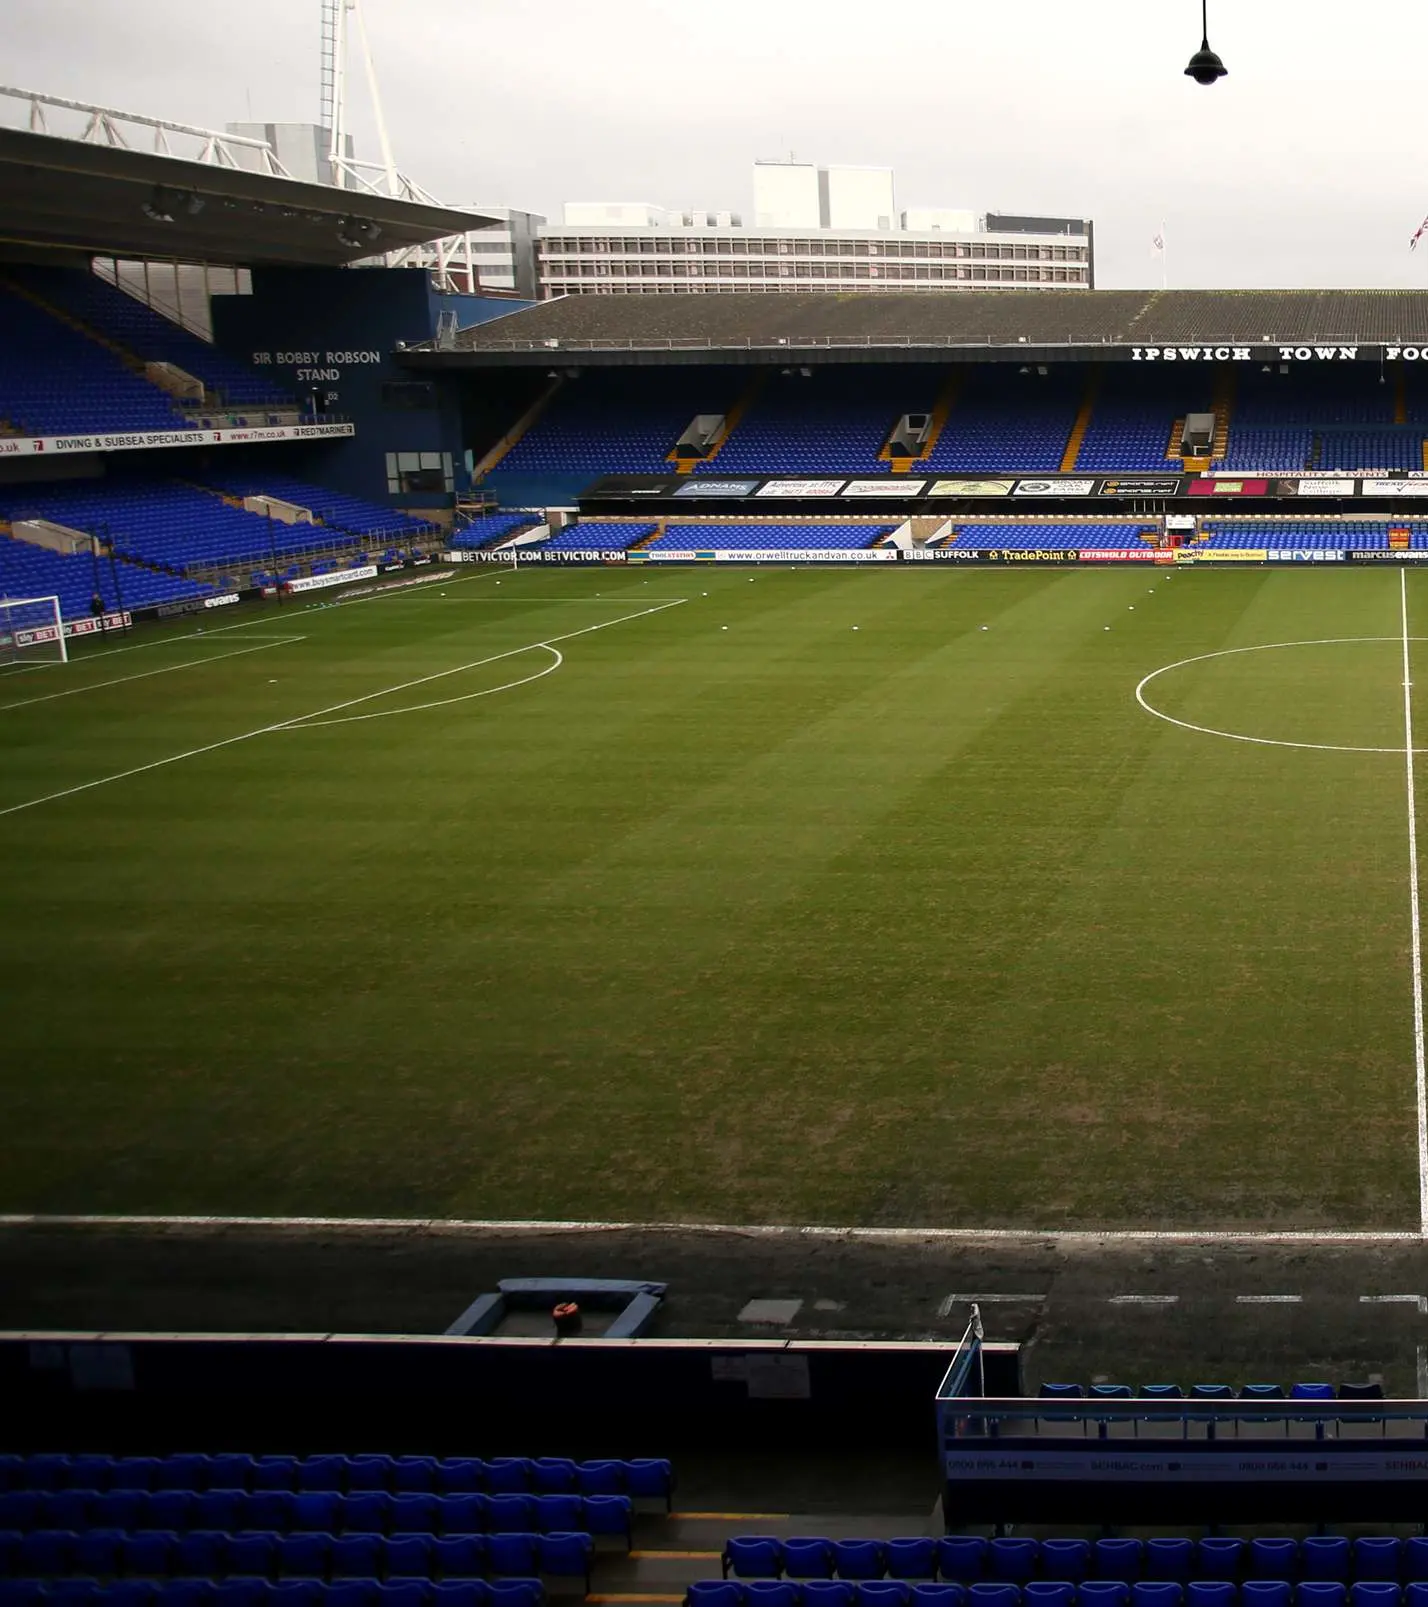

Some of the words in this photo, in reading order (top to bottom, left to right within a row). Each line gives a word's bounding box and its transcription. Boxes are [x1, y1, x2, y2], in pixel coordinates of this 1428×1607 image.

[253, 352, 272, 365] SIR
[276, 352, 320, 364] BOBBY
[326, 351, 381, 363] ROBSON
[1131, 347, 1251, 361] IPSWICH
[1279, 347, 1358, 361] TOWN
[296, 368, 340, 381] STAND
[56, 438, 92, 450] DIVING
[94, 437, 102, 447] &
[105, 435, 147, 447] SUBSEA
[147, 433, 204, 445] SPECIALISTS
[683, 483, 747, 491] ADNAMS
[461, 551, 542, 561] BETVICTOR.COM
[544, 551, 626, 561] BETVICTOR.COM
[728, 551, 878, 560] www.orwelltruckandvan.co.uk
[904, 551, 934, 560] BBC
[934, 551, 979, 559] SUFFOLK
[1002, 550, 1064, 560] TradePoint
[1079, 551, 1127, 559] COTSWOLD
[1128, 551, 1173, 559] OUTDOOR
[1177, 550, 1204, 560] Peachy
[1268, 550, 1344, 560] servest
[293, 567, 375, 590] www.buysmartcard.com
[35, 629, 55, 640] BET
[75, 622, 93, 632] BET
[948, 1460, 975, 1470] 0800
[998, 1460, 1019, 1469] 444
[1090, 1461, 1164, 1471] SEHBAC.com
[1238, 1461, 1265, 1471] 0800
